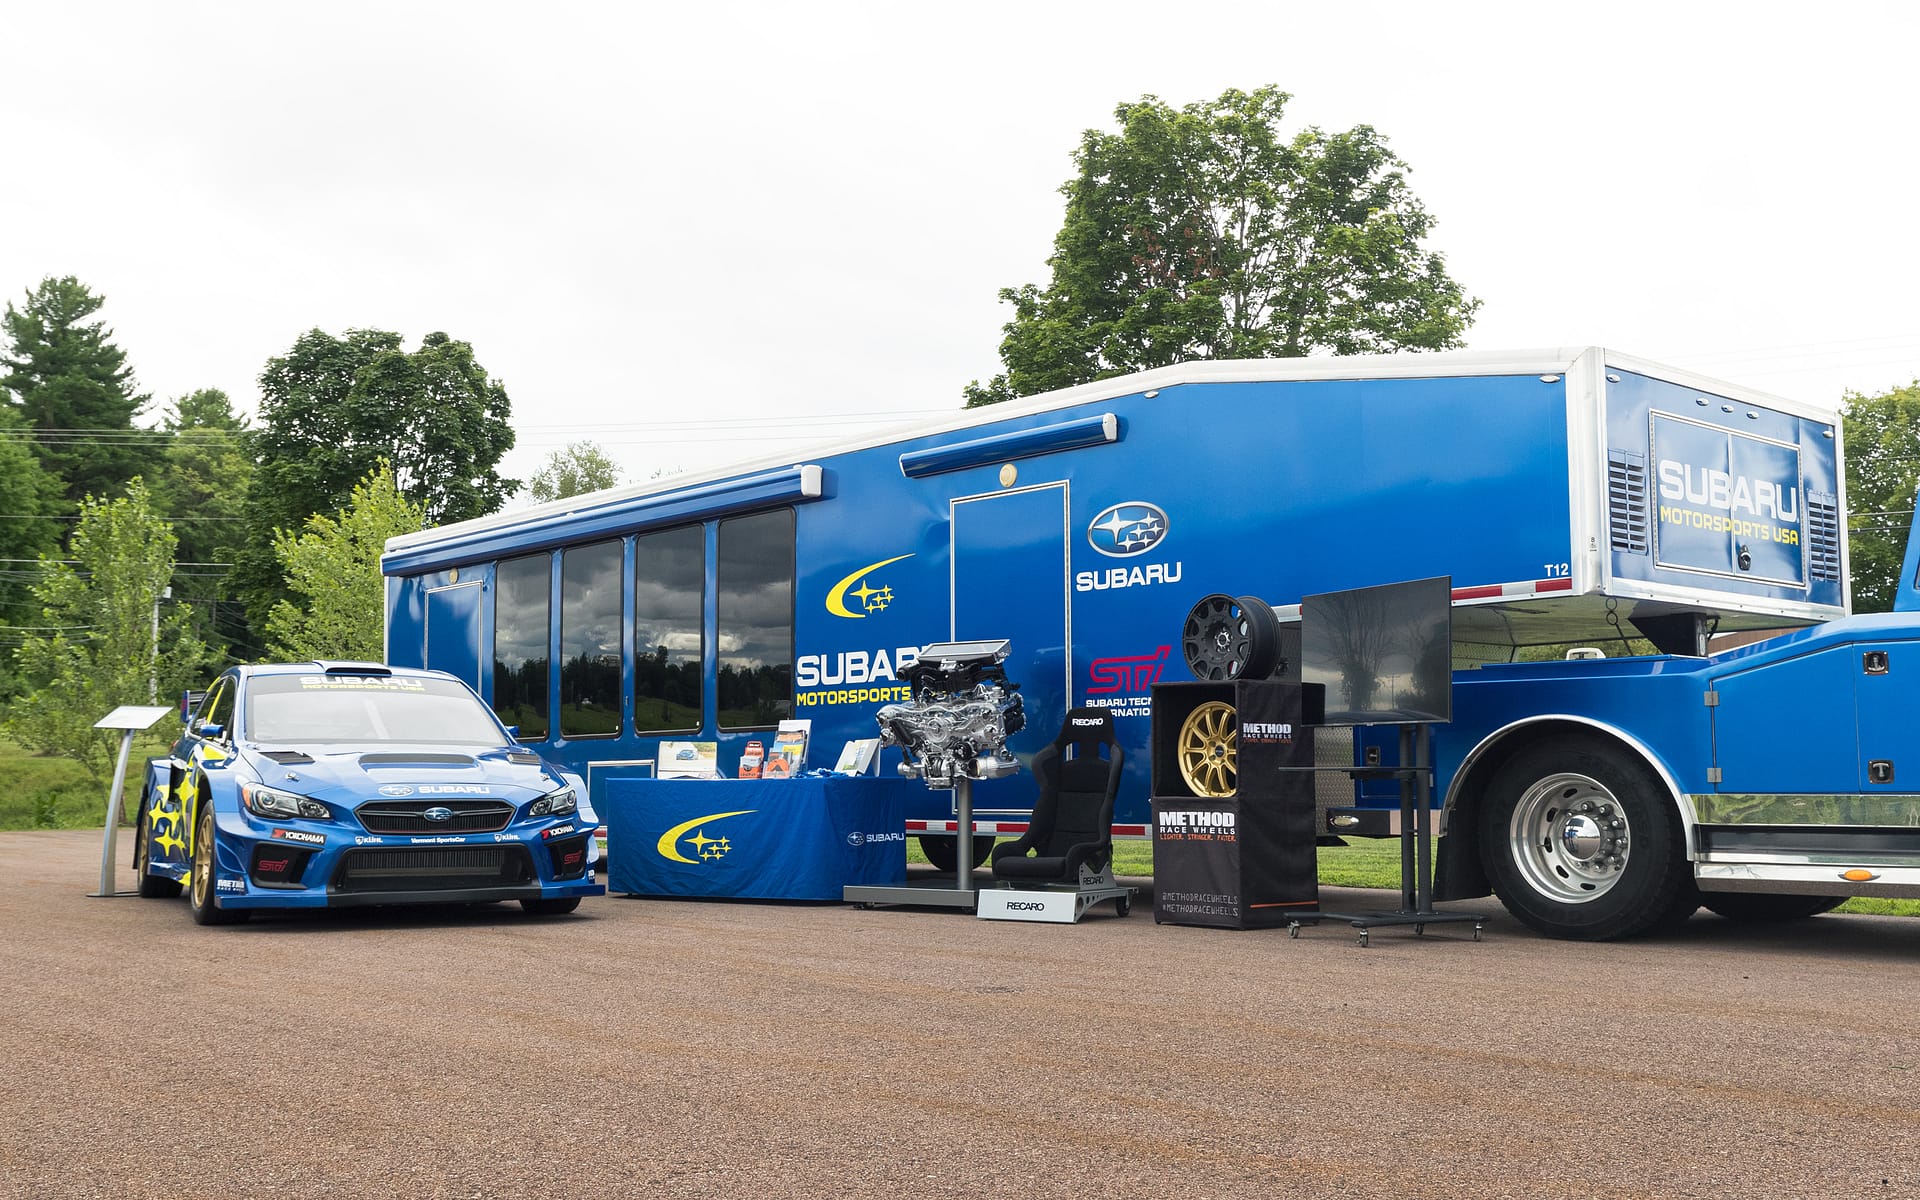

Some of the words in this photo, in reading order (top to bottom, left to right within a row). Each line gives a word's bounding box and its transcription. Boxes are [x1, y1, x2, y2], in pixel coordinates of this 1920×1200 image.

[1659, 459, 1797, 523] SUBARU
[1660, 505, 1769, 540] MOTORSPORTS
[1773, 527, 1799, 546] USA
[1544, 563, 1569, 577] T12
[1076, 562, 1182, 592] SUBARU
[797, 646, 928, 687] SUBAR
[299, 676, 422, 687] SUBARU
[797, 686, 911, 706] MOTORSPORTS
[1086, 699, 1127, 708] SUBARU
[1072, 718, 1104, 726] RECARO
[1243, 723, 1292, 734] METHOD
[419, 786, 490, 794] SUBARU
[1159, 812, 1235, 827] METHOD
[1160, 826, 1187, 834] RACE
[285, 831, 324, 844] YOKOHAMA
[866, 833, 905, 843] SUBARU
[1083, 876, 1104, 885] RECARO
[1162, 892, 1238, 904] @METHODRACEWHEELS
[1006, 901, 1045, 911] RECARO
[1163, 904, 1239, 916] #METHODRACEWHEELS
